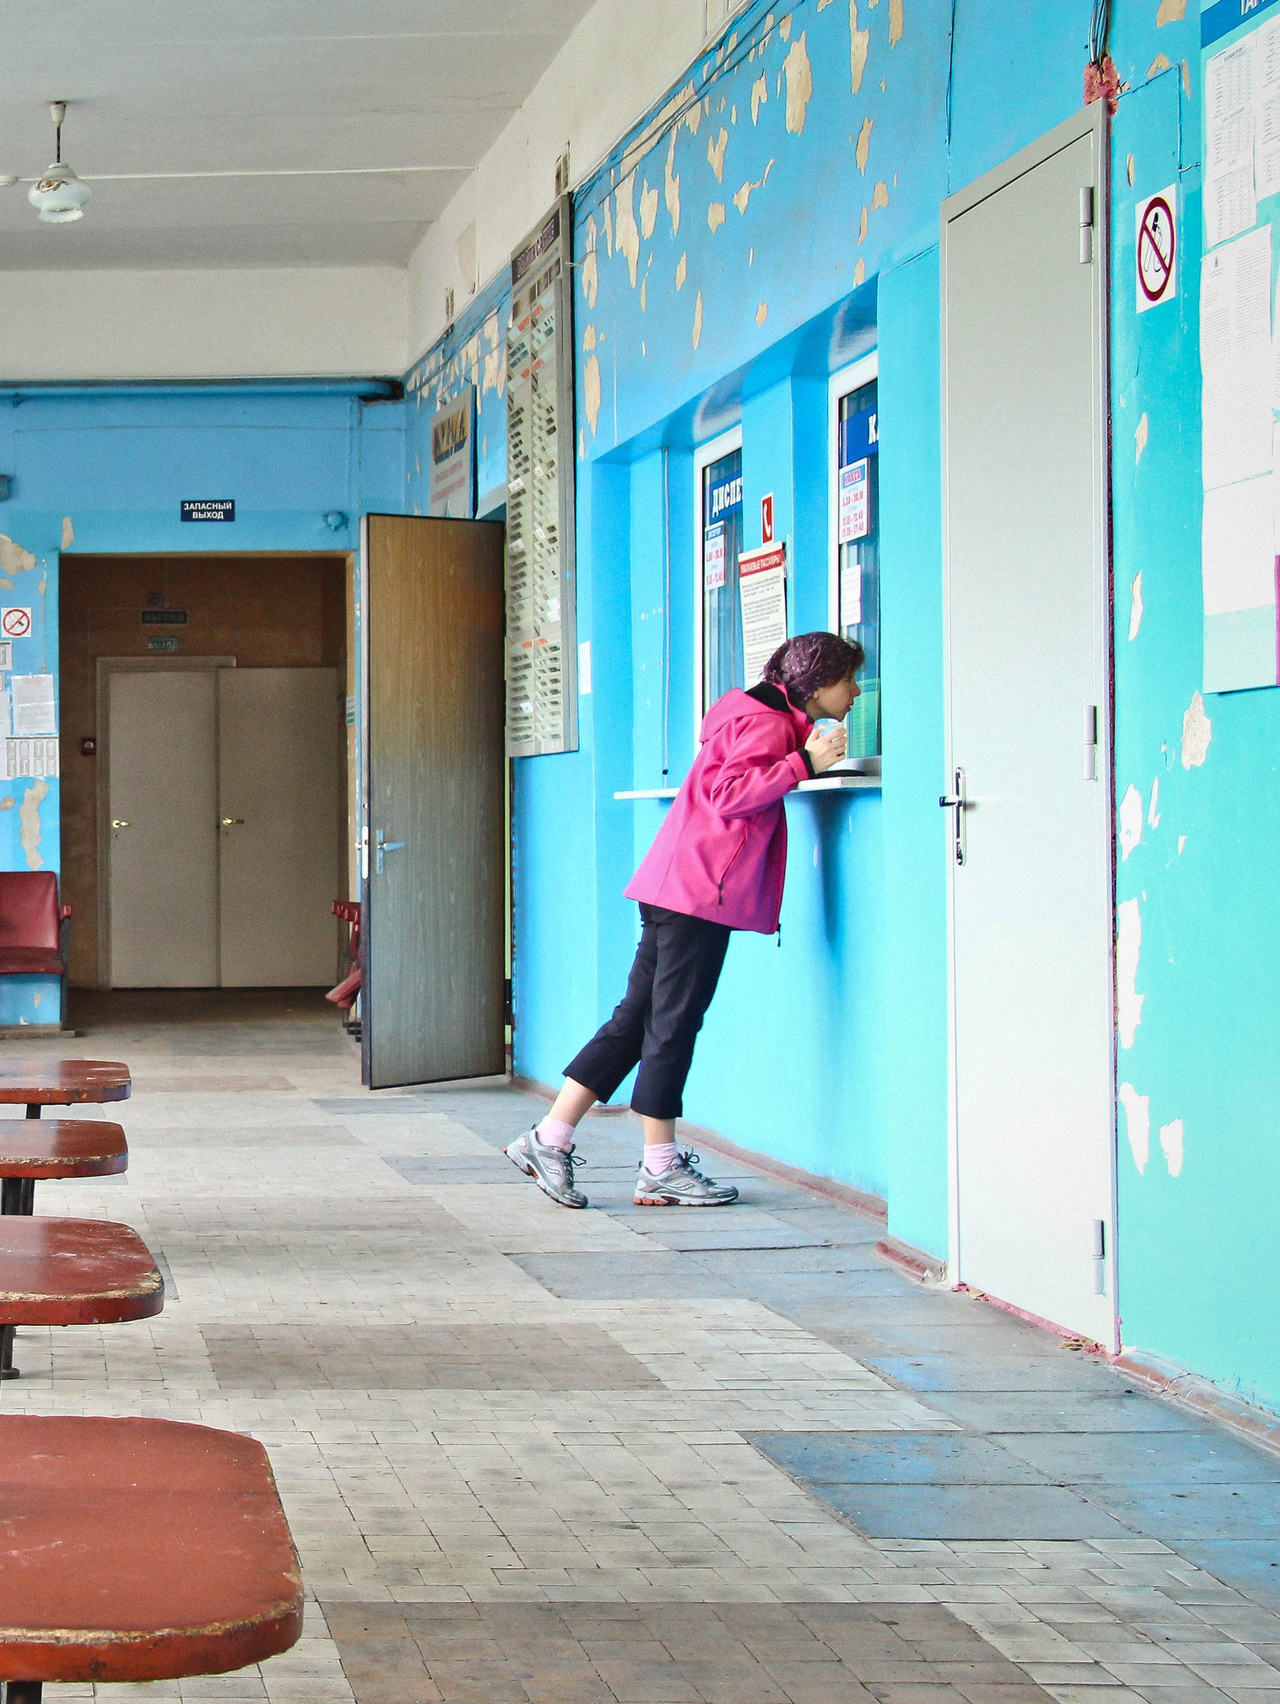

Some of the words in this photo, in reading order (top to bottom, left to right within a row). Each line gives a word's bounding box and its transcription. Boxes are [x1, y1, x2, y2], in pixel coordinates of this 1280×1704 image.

[868, 414, 879, 445] К
[183, 501, 233, 511] ЗАПАСНЫЙ
[192, 511, 224, 520] ВЫХОД
